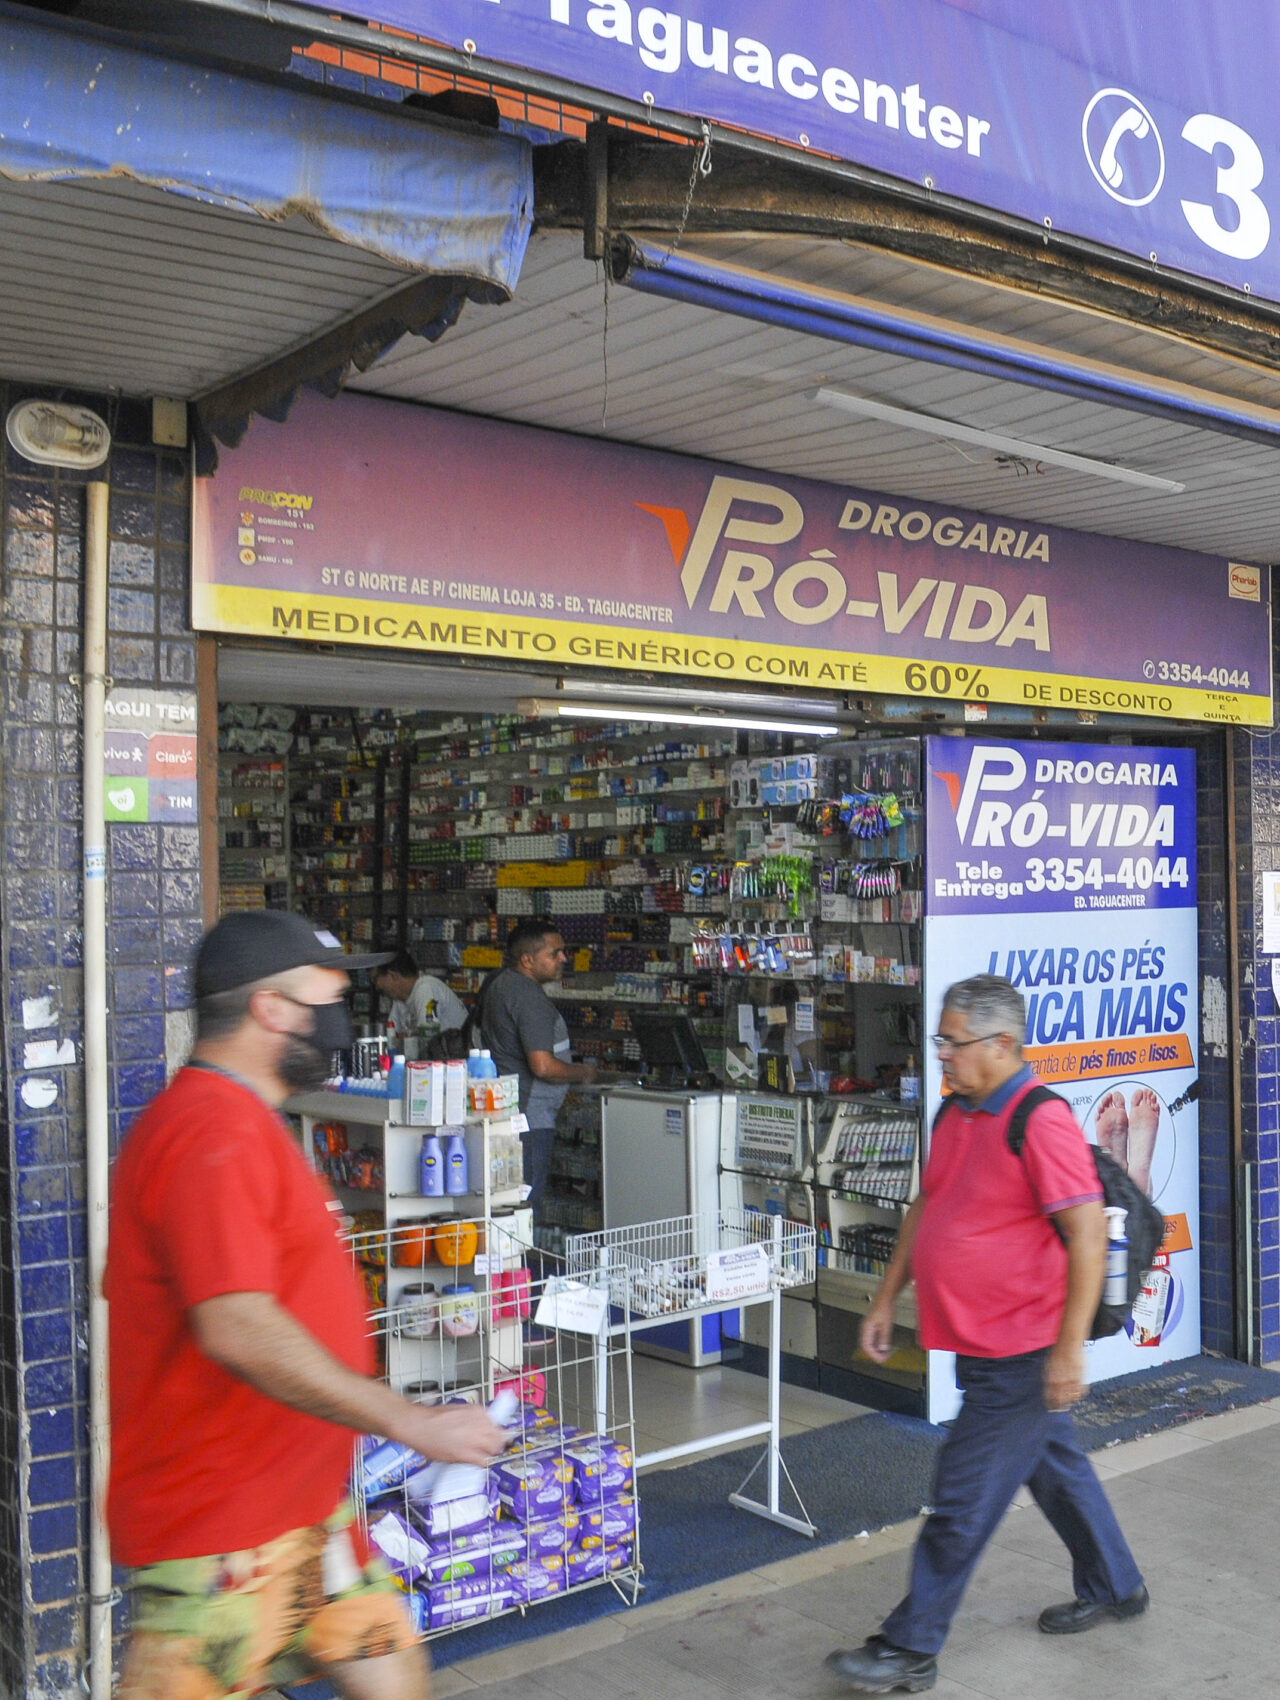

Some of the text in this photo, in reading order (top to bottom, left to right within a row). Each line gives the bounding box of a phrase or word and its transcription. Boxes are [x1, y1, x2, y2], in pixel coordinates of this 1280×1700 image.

[238, 487, 314, 511] PROCON
[287, 508, 305, 519] 151
[838, 500, 1052, 563] DROGARIA
[681, 475, 1052, 653] PRÓ-VIDA
[321, 567, 341, 587] ST
[344, 570, 355, 588] G
[359, 572, 408, 594] NORTE
[411, 579, 430, 596] AE
[433, 581, 446, 598] P/
[449, 582, 501, 605] CINEMA
[503, 588, 536, 608] LOJA
[540, 591, 554, 610] 35
[565, 594, 585, 614] ED.
[587, 597, 674, 625] TAGUACENTER
[271, 605, 1174, 714] MEDICAMENTO GENÉRICO COM ATÉ 60% DE DESCONTO
[1158, 660, 1250, 690] 3354-4044
[104, 699, 195, 721] AQUI TEM
[1206, 692, 1239, 704] TERÇA
[1203, 711, 1241, 722] QUINTA
[104, 747, 188, 764] vivo Claro
[1034, 758, 1179, 788] DROGARIA
[168, 795, 193, 809] TIM
[957, 746, 1176, 849] PRÓ-VIDA
[956, 861, 1004, 881] Tele
[1024, 856, 1189, 891] 3354-4044
[934, 877, 1024, 900] Entrega
[1073, 894, 1147, 909] ED. TAGUACENTER
[1083, 949, 1116, 984] OS
[1120, 939, 1166, 982] PÉS
[1096, 982, 1188, 1040] MAIS
[1062, 1052, 1077, 1073] de
[1079, 1049, 1103, 1075] pés
[1106, 1048, 1137, 1068] finos
[1138, 1049, 1147, 1064] e
[1148, 1043, 1180, 1063] lisos.
